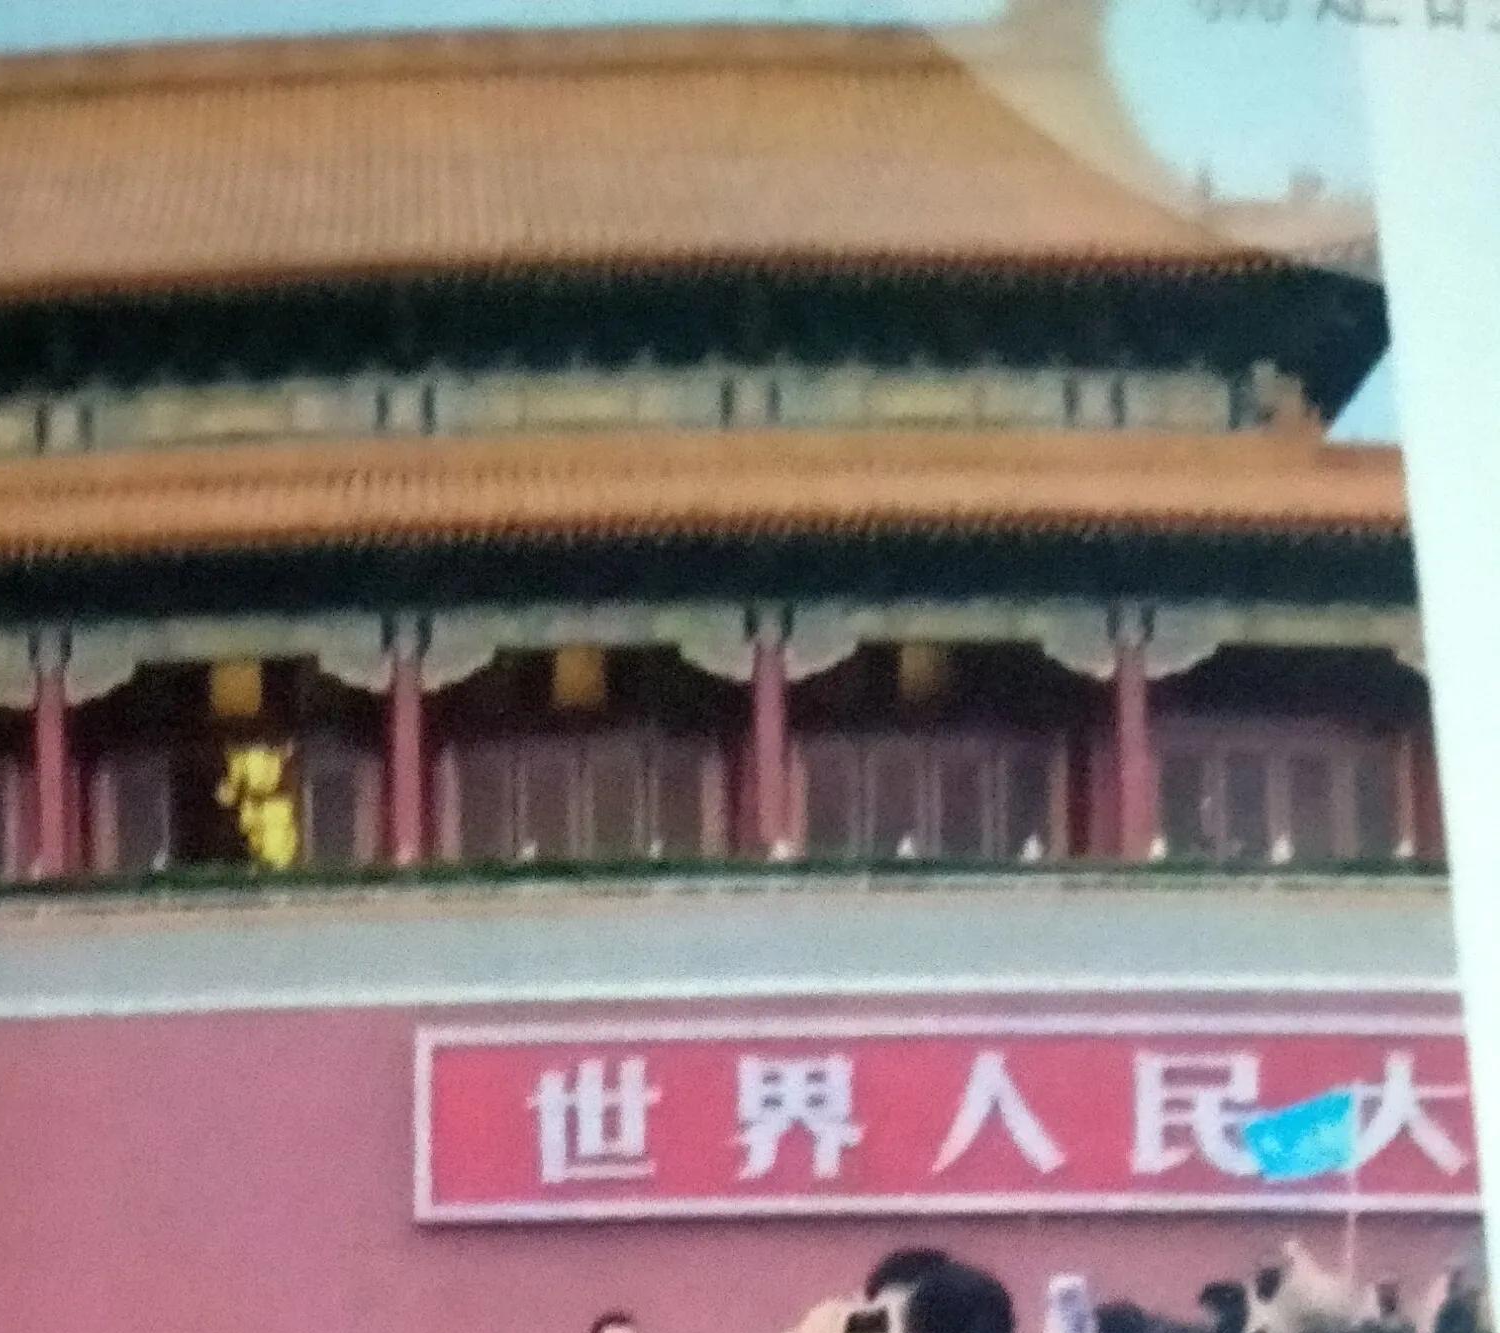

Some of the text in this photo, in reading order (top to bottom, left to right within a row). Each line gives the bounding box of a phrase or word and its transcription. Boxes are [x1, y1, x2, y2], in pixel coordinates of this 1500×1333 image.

[527, 1050, 1470, 1184] 世界人民大
